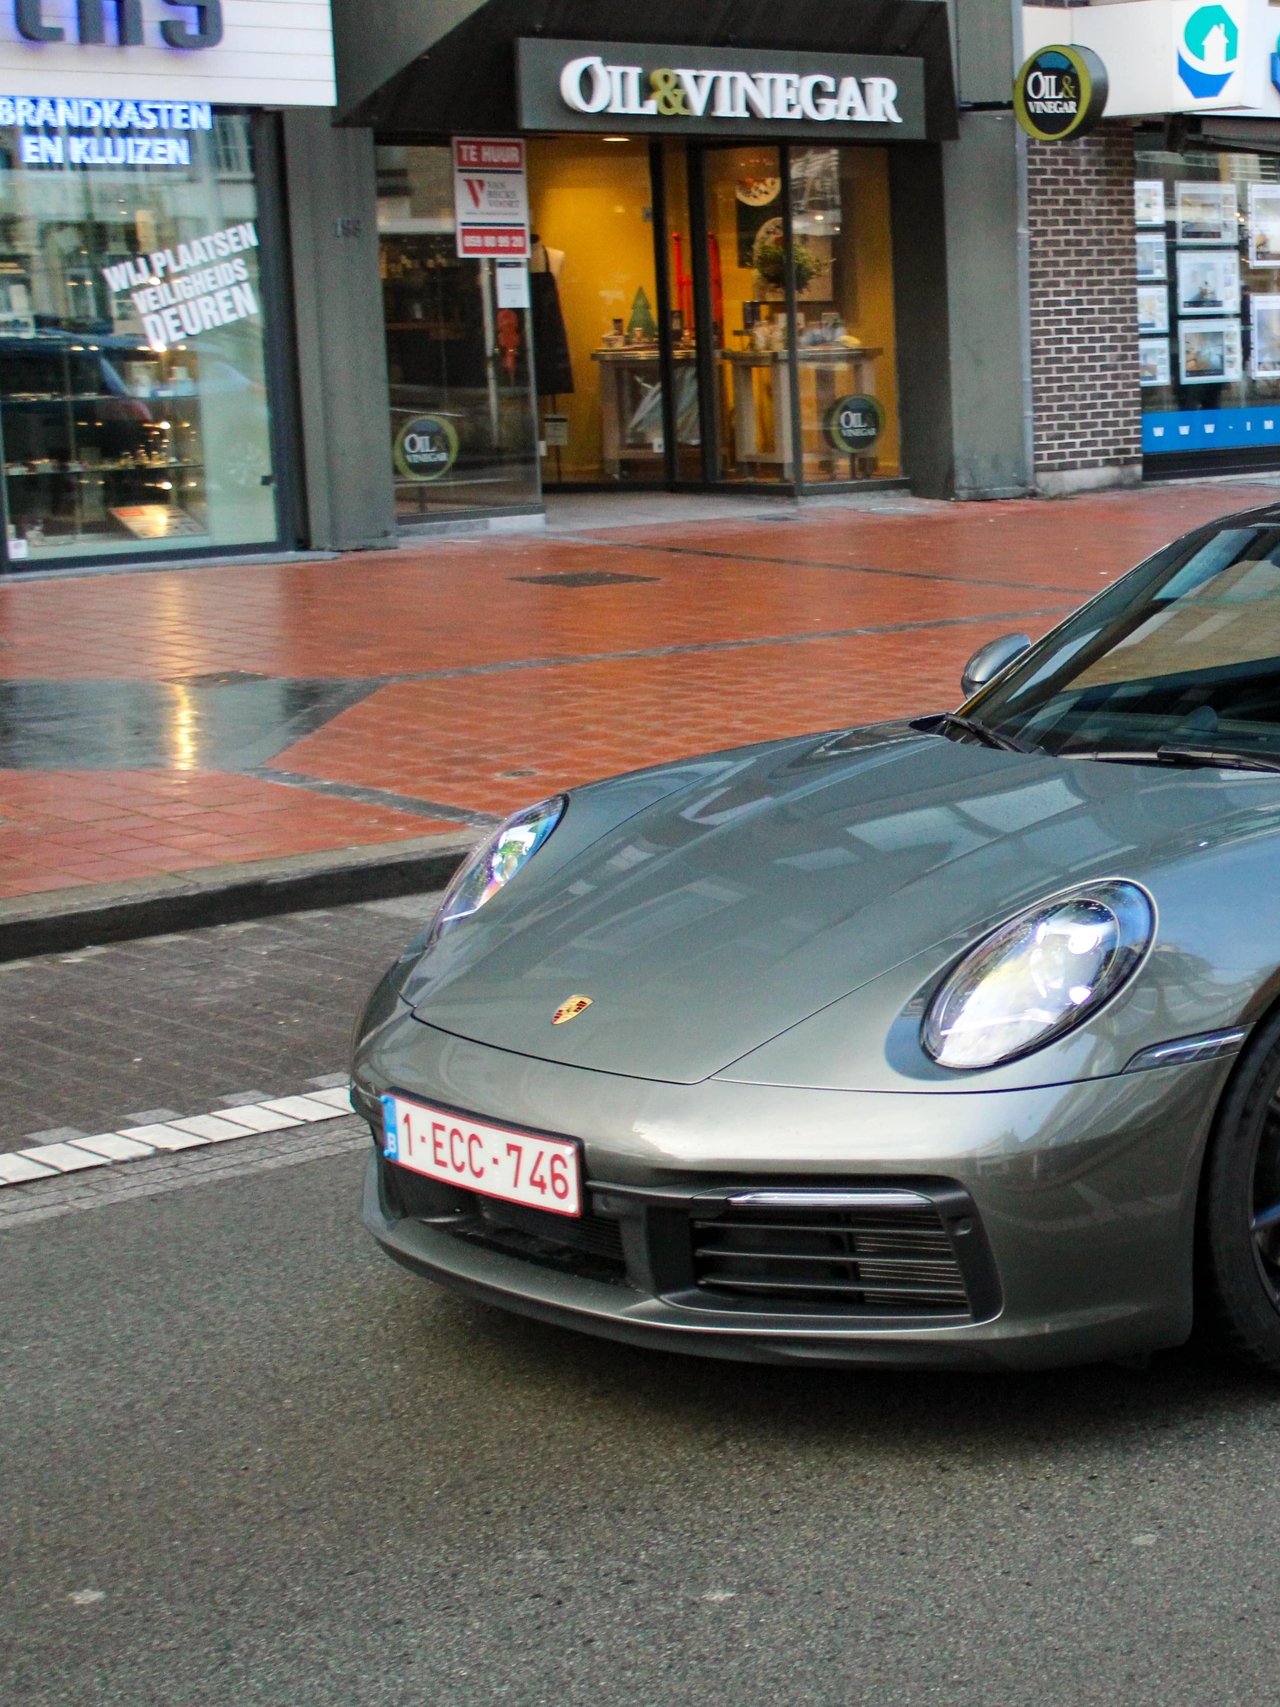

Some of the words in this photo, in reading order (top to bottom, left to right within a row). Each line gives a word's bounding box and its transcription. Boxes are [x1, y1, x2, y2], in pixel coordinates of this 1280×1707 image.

[0, 96, 213, 130] BRANDKASTEN
[1027, 101, 1077, 114] VINEGAR
[21, 135, 64, 164] EN
[69, 136, 191, 165] KLUIZEN
[459, 144, 479, 163] TE
[101, 257, 151, 293] WIJ
[150, 221, 260, 278] PLAATSEN
[130, 257, 249, 314] VEILIGHEIDS
[141, 282, 259, 350] DEUREN
[386, 1132, 397, 1153] B
[403, 1112, 569, 1200] 1-ECC-746
